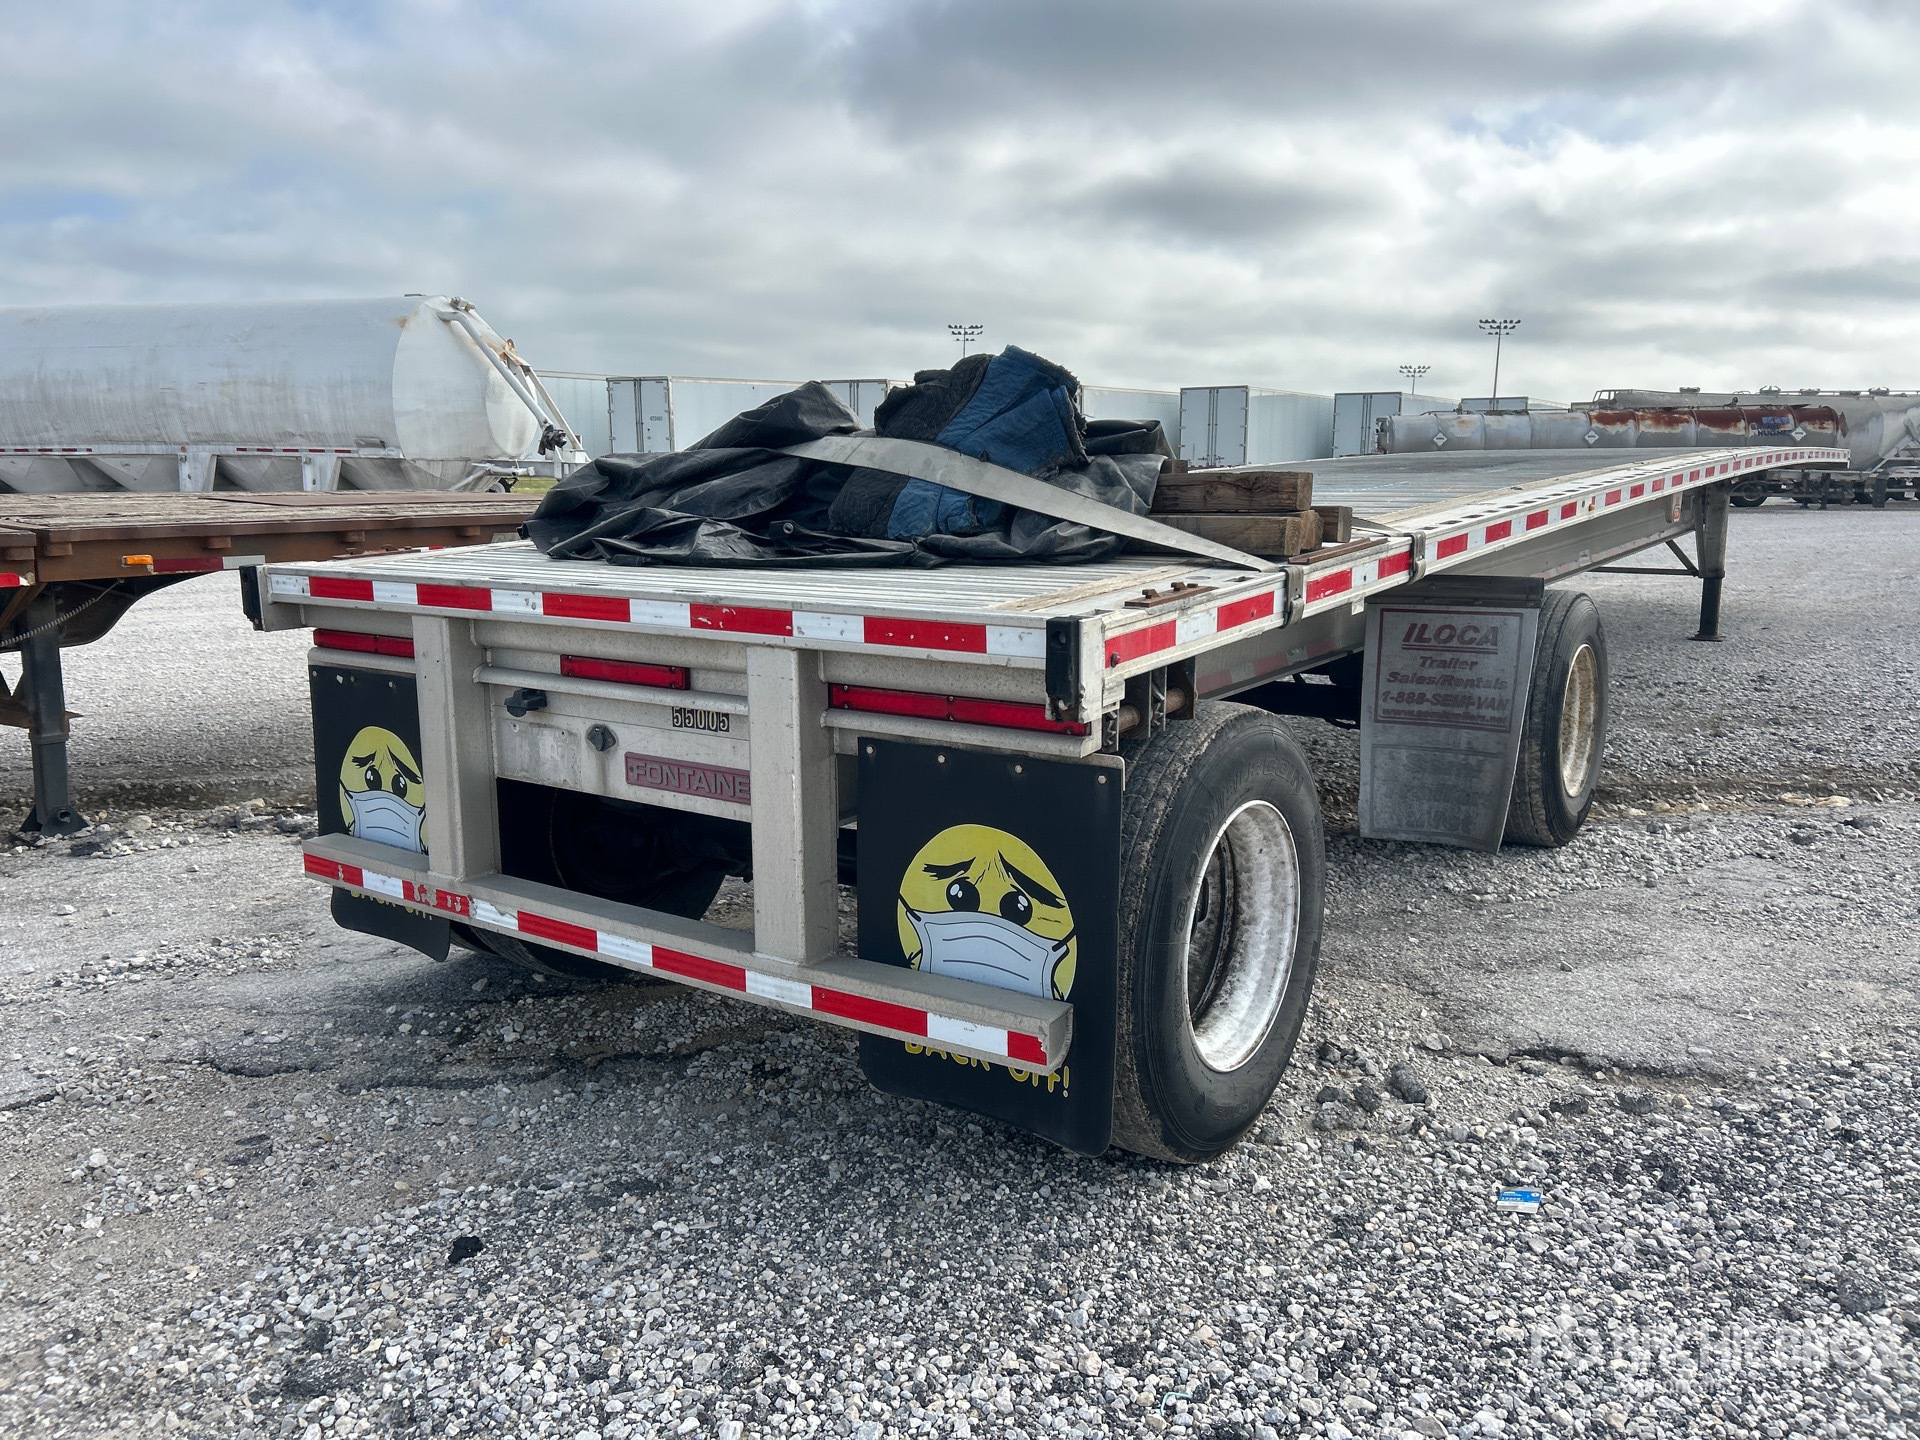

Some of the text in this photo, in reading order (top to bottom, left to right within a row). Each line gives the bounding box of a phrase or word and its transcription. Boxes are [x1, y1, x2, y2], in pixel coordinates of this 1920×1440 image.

[1402, 622, 1499, 647] ILOCA
[1419, 655, 1479, 671] Trailer
[1386, 671, 1508, 690] Sales/Rentals
[672, 707, 729, 732] 55005
[632, 761, 750, 799] FONTAINE
